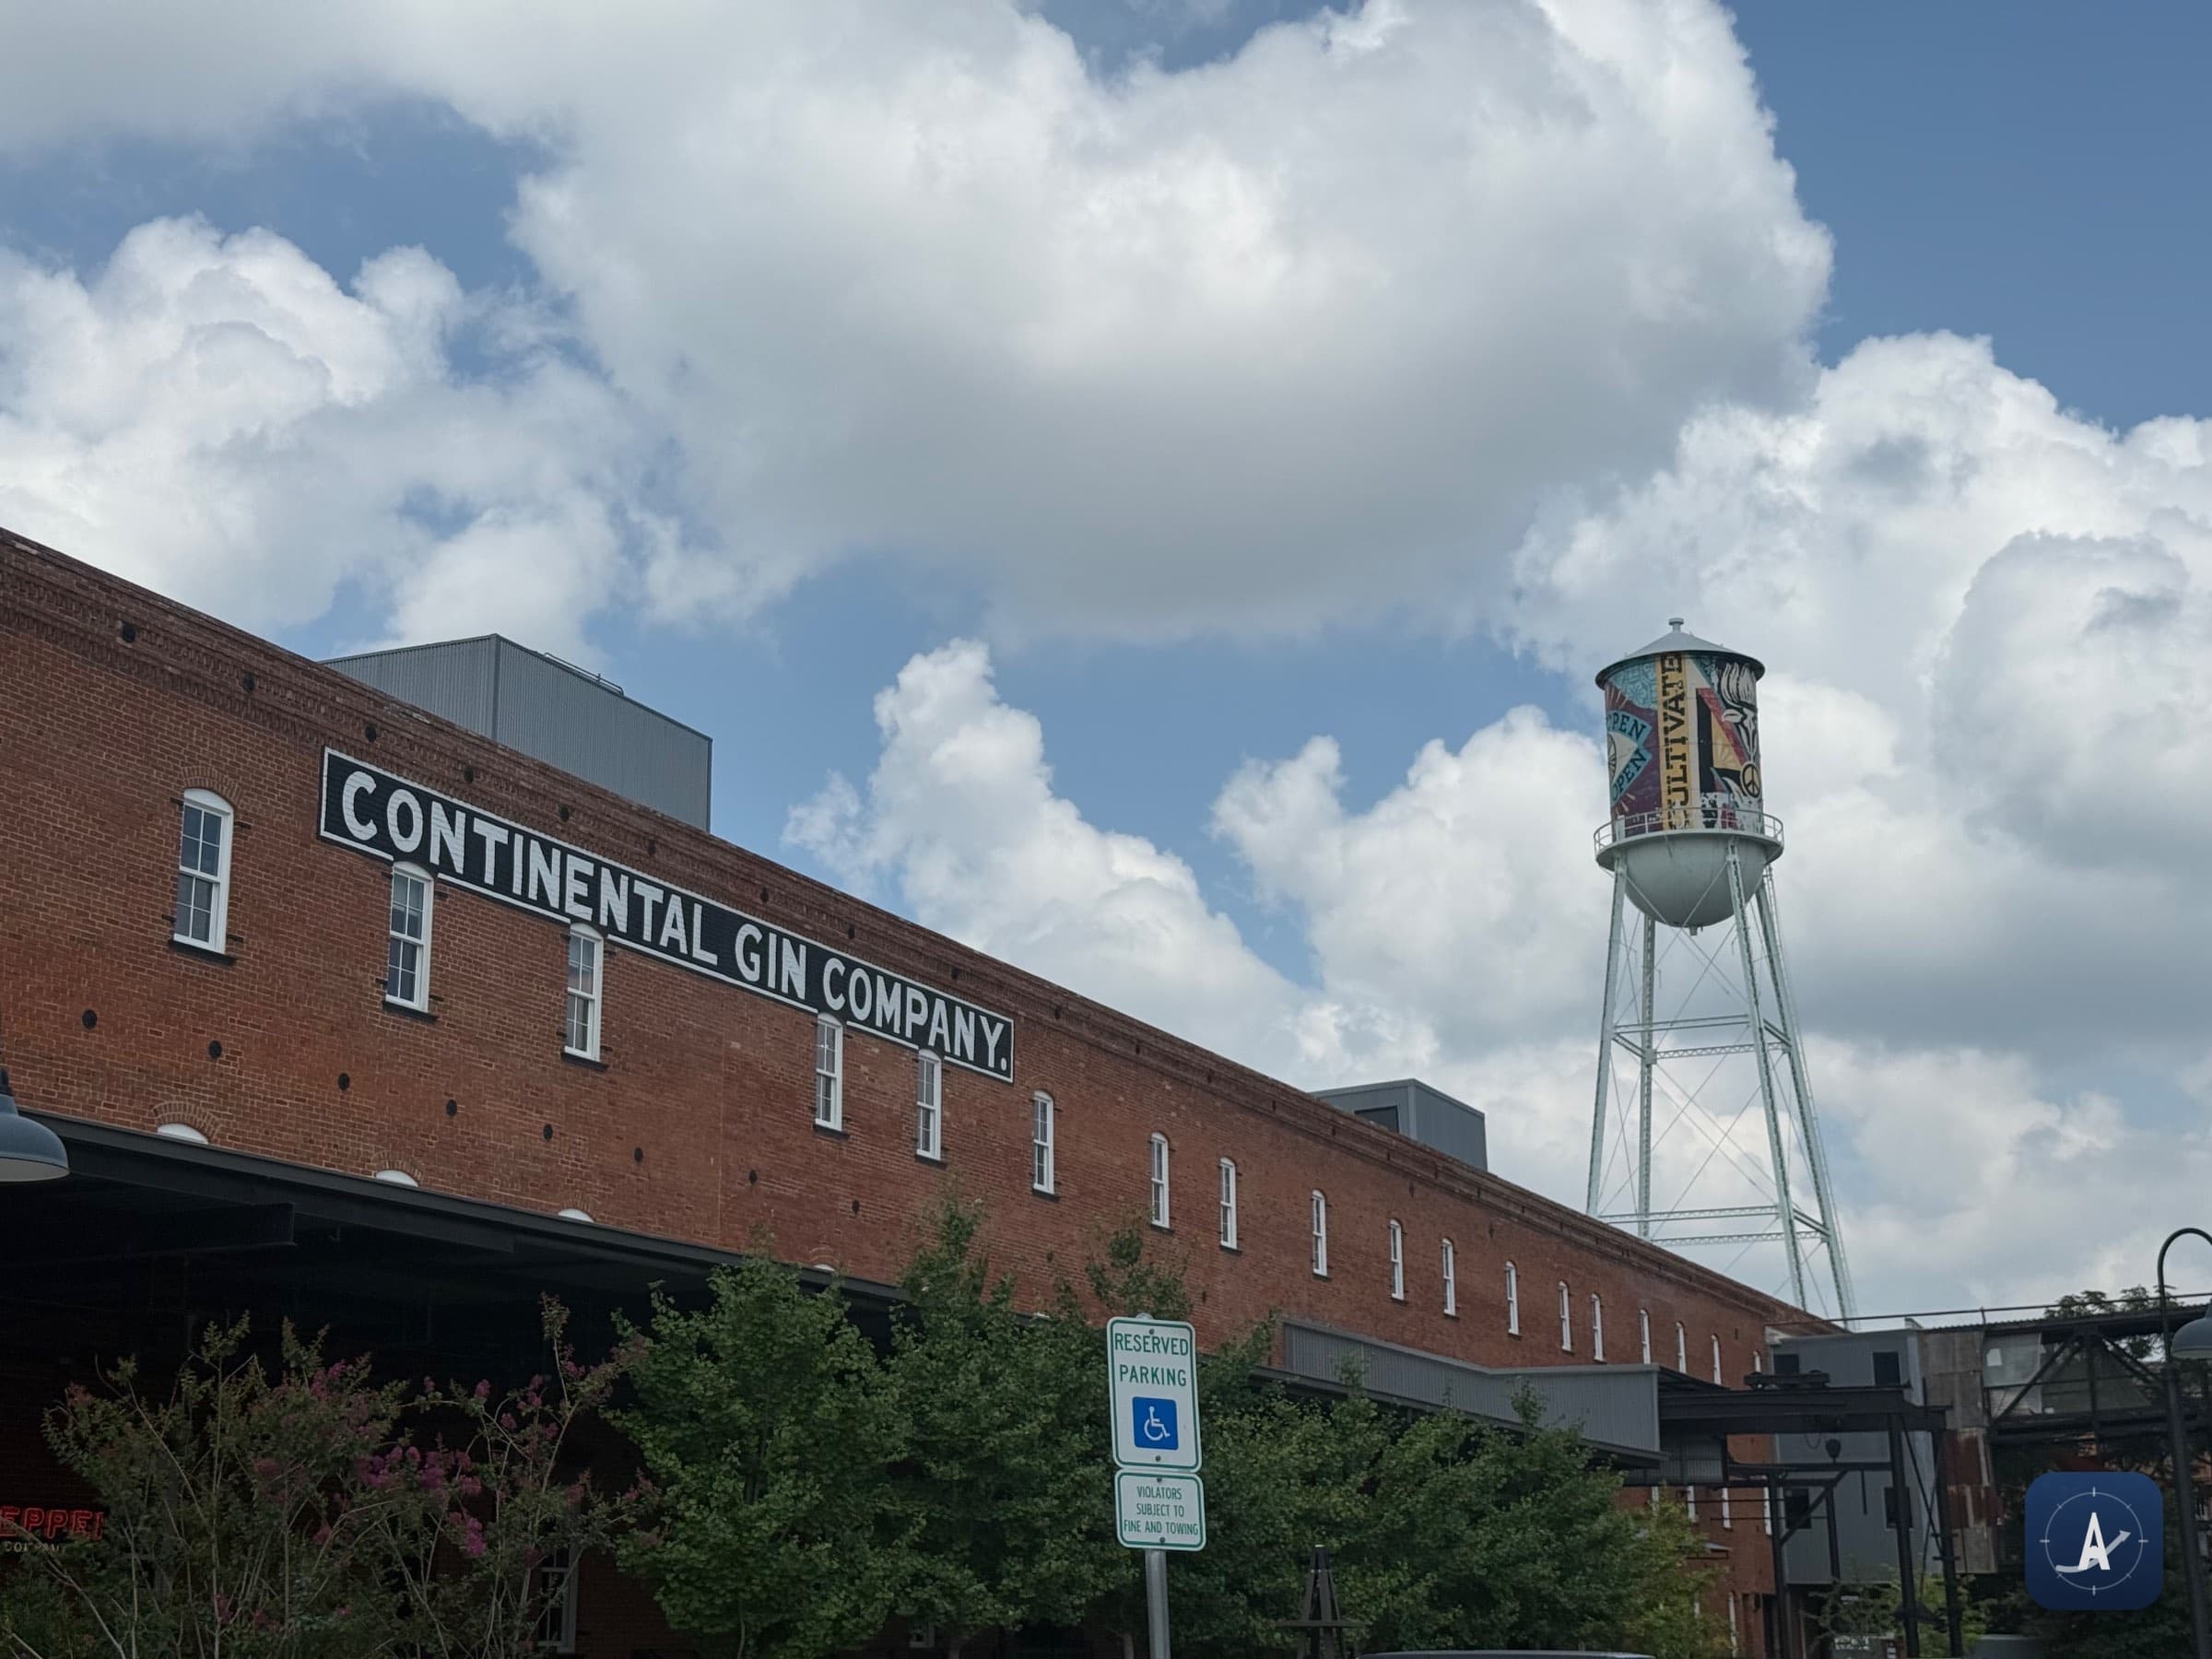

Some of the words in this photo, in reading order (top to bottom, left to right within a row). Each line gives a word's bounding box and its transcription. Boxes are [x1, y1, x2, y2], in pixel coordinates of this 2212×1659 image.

[1606, 712, 1646, 741] PEN
[341, 771, 718, 966] CONTINENTAL
[735, 923, 807, 1000] GIN
[822, 958, 1008, 1071] COMPANY.
[1114, 1333, 1189, 1357] RESERVED
[1120, 1364, 1187, 1387] PARKING
[1136, 1486, 1182, 1500] VIOLATORS
[1136, 1502, 1170, 1517] SUBJECT
[1173, 1504, 1185, 1518] TO
[1124, 1519, 1141, 1533] FINE
[1144, 1520, 1162, 1534] AND
[1165, 1522, 1199, 1535] TOWING
